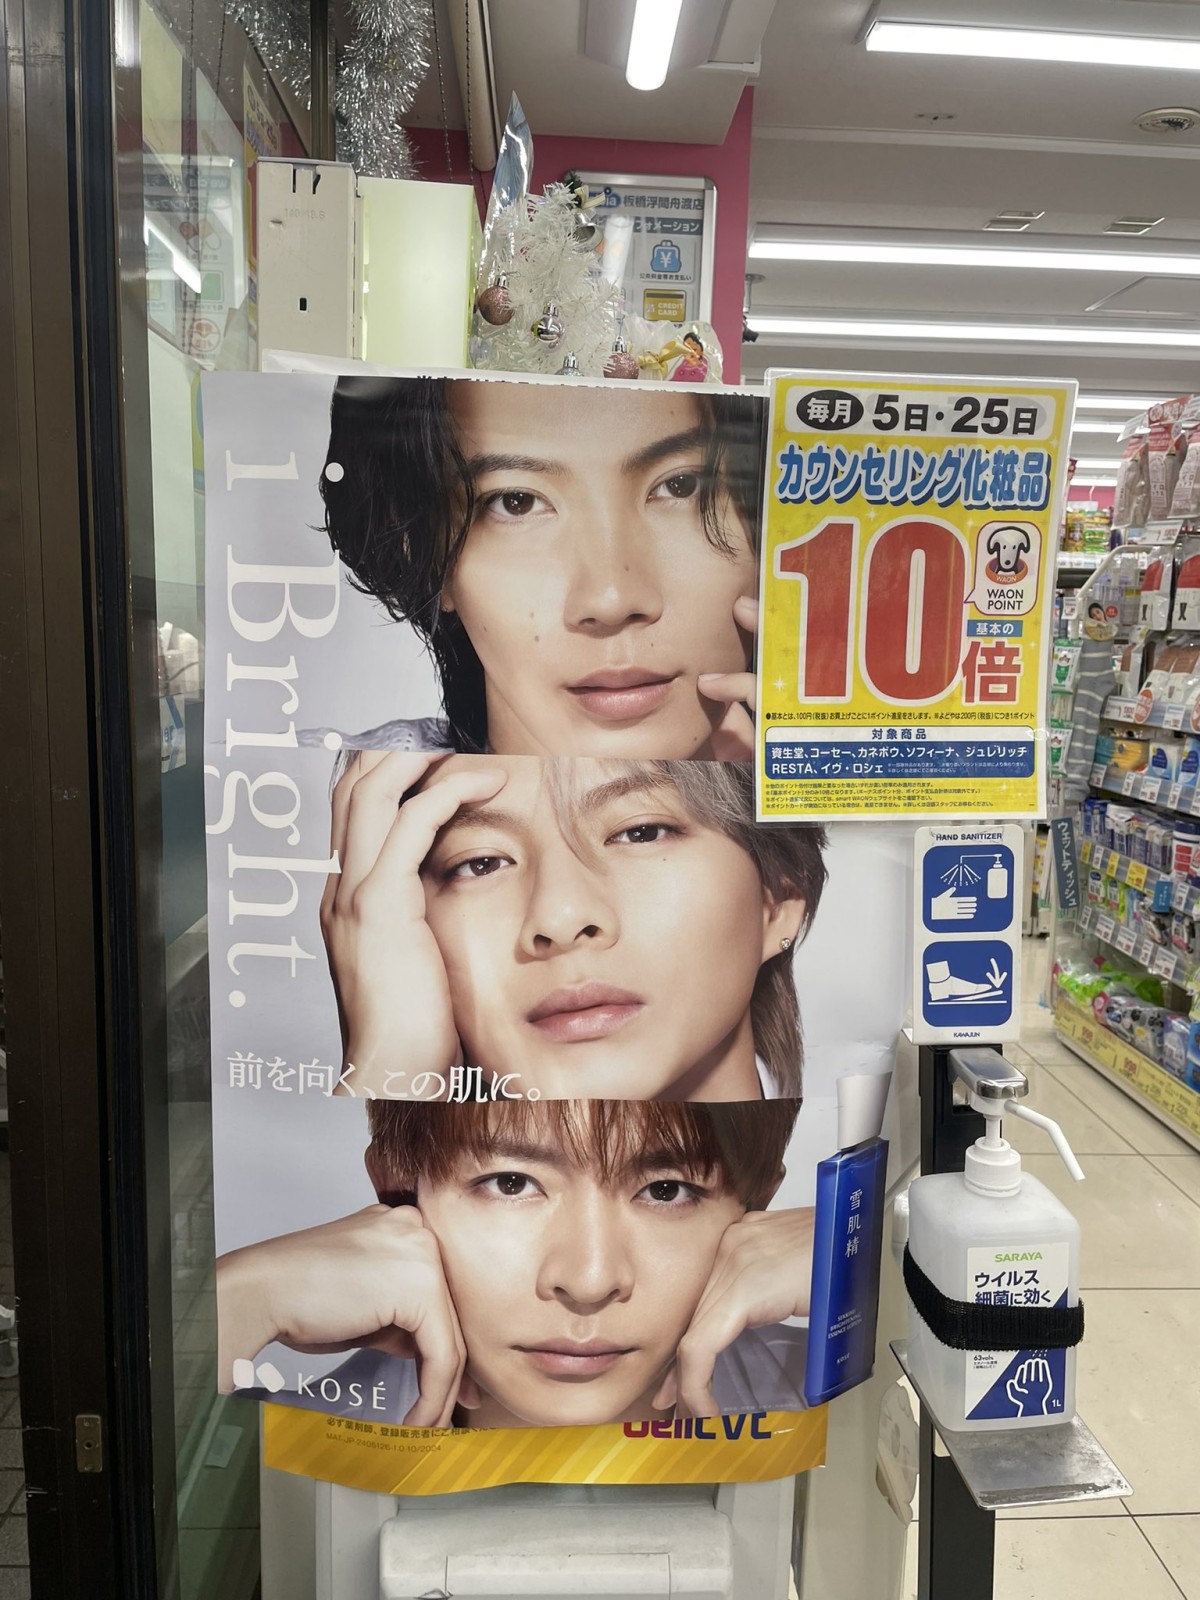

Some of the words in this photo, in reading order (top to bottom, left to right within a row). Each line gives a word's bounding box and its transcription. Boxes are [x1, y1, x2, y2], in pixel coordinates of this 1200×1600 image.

[806, 397, 852, 424] 毎月
[777, 443, 1048, 503] カウンセリング化粧品
[987, 589, 1024, 599] WAON
[779, 521, 966, 701] 10
[987, 600, 1024, 610] POINT
[976, 622, 1014, 636] 基本の
[962, 641, 1021, 704] 倍
[872, 728, 927, 740] 対象商品
[205, 545, 344, 1008] Bright.
[772, 763, 884, 775] RESTA、イヴ・ロシェ
[936, 833, 958, 841] HAND
[961, 832, 1002, 841] SANITIZER
[226, 1050, 541, 1104] 前を向く、この肌に。
[844, 1188, 863, 1259] 雪肌精
[994, 1252, 1043, 1263] SARAYA
[975, 1269, 1040, 1288] ウイルス
[975, 1288, 1051, 1307] 細菌に効く
[297, 1372, 387, 1411] KOSÉ
[1052, 1399, 1062, 1408] 1L
